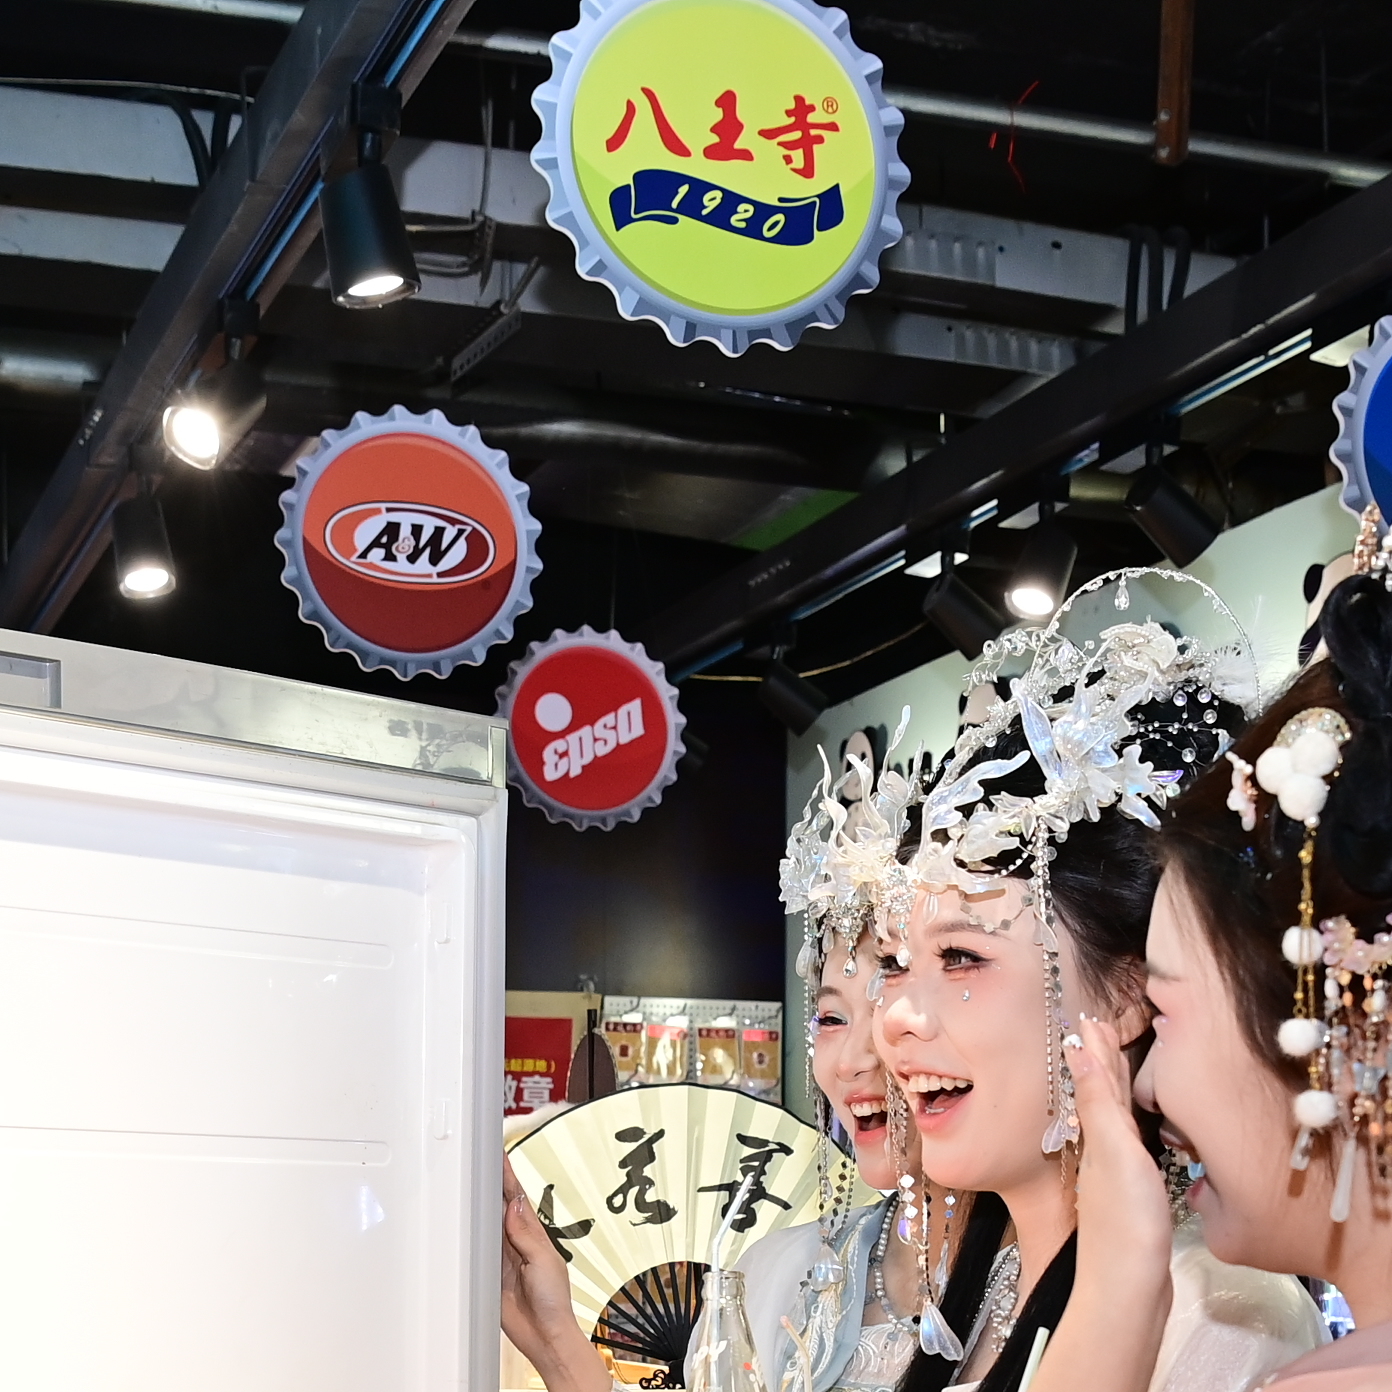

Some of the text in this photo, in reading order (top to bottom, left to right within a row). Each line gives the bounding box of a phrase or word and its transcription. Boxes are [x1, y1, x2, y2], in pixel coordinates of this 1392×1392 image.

[605, 86, 840, 179] 八王寺
[670, 183, 786, 238] 1920
[355, 520, 467, 569] A&W
